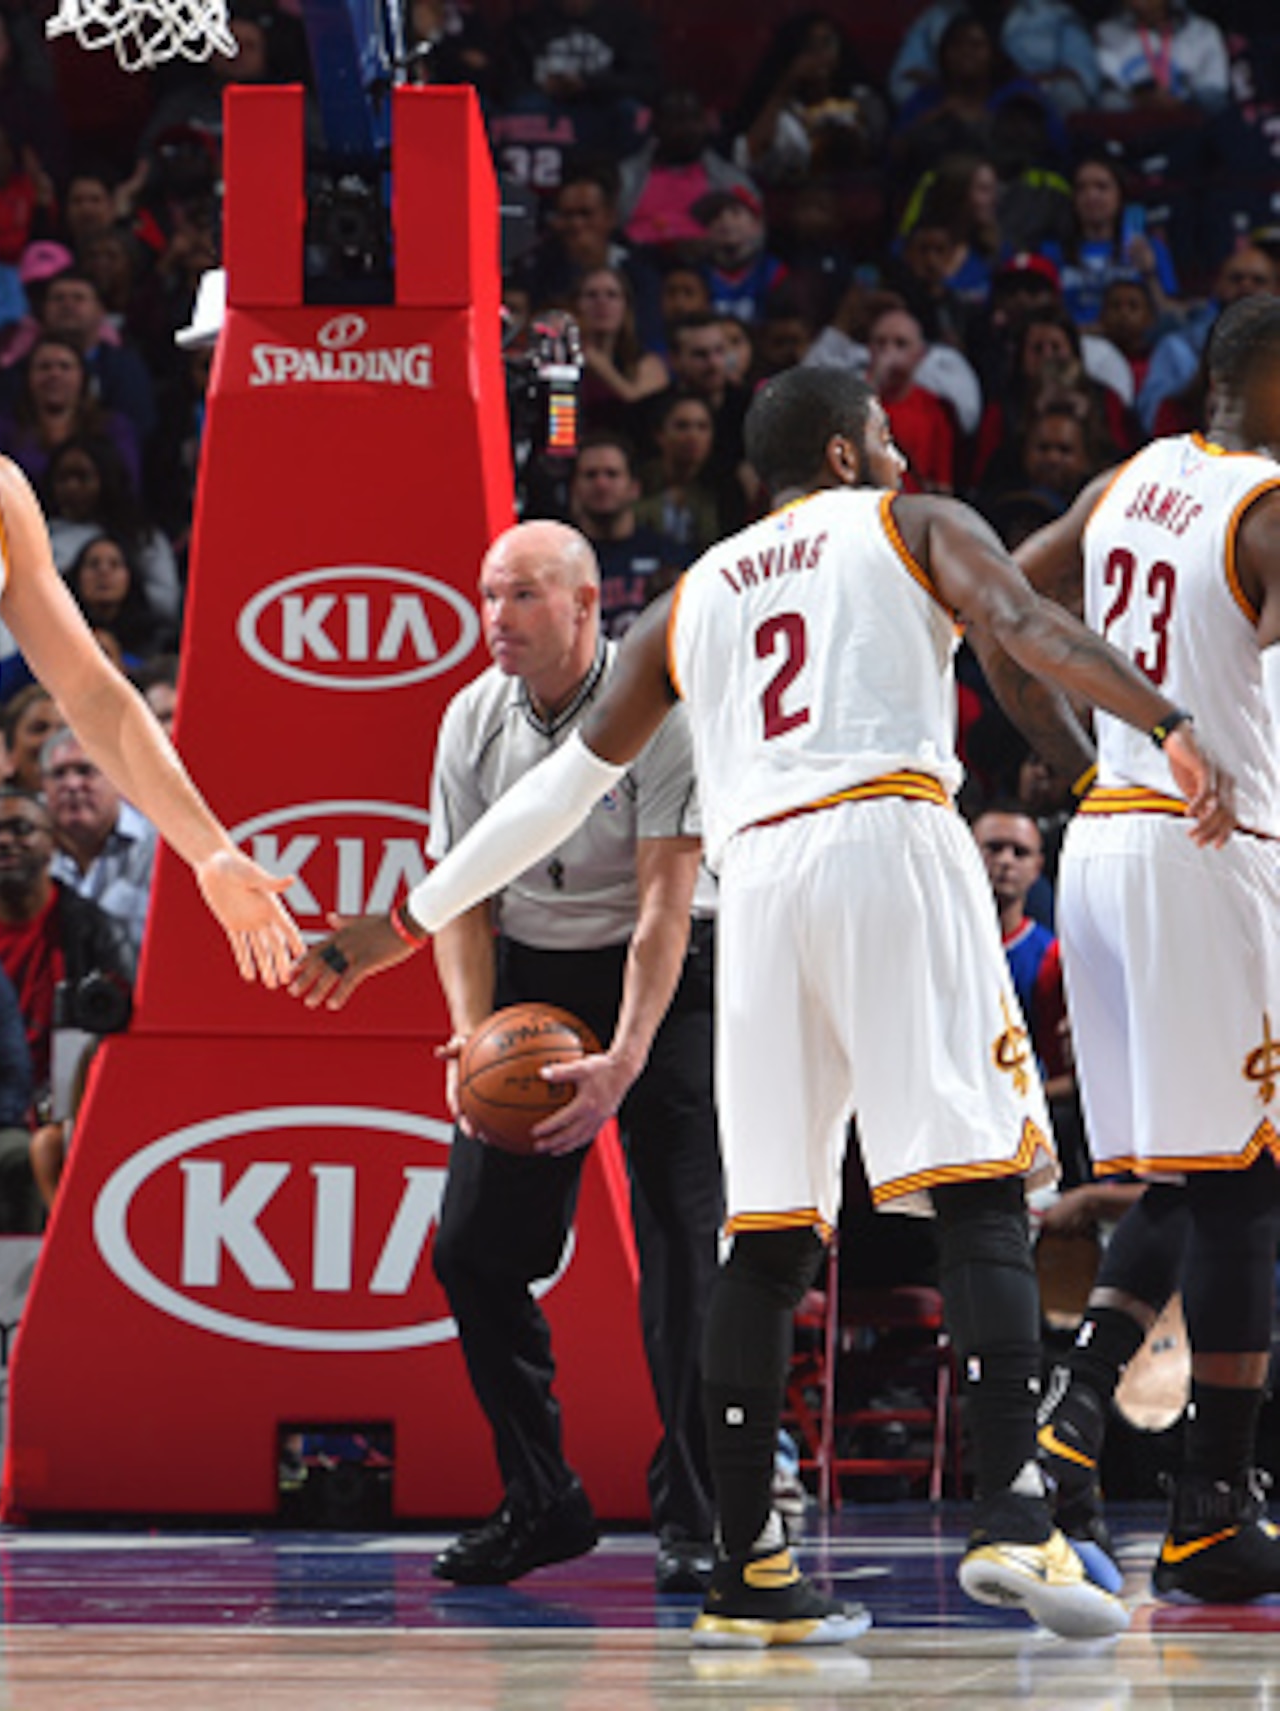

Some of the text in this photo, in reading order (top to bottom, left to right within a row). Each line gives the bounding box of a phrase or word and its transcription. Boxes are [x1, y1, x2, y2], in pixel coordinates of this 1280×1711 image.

[503, 147, 562, 186] 32
[249, 344, 433, 388] SPALDING
[280, 594, 439, 661] KIA
[1104, 548, 1176, 686] 23
[755, 612, 810, 741] 2
[252, 834, 431, 915] KIA
